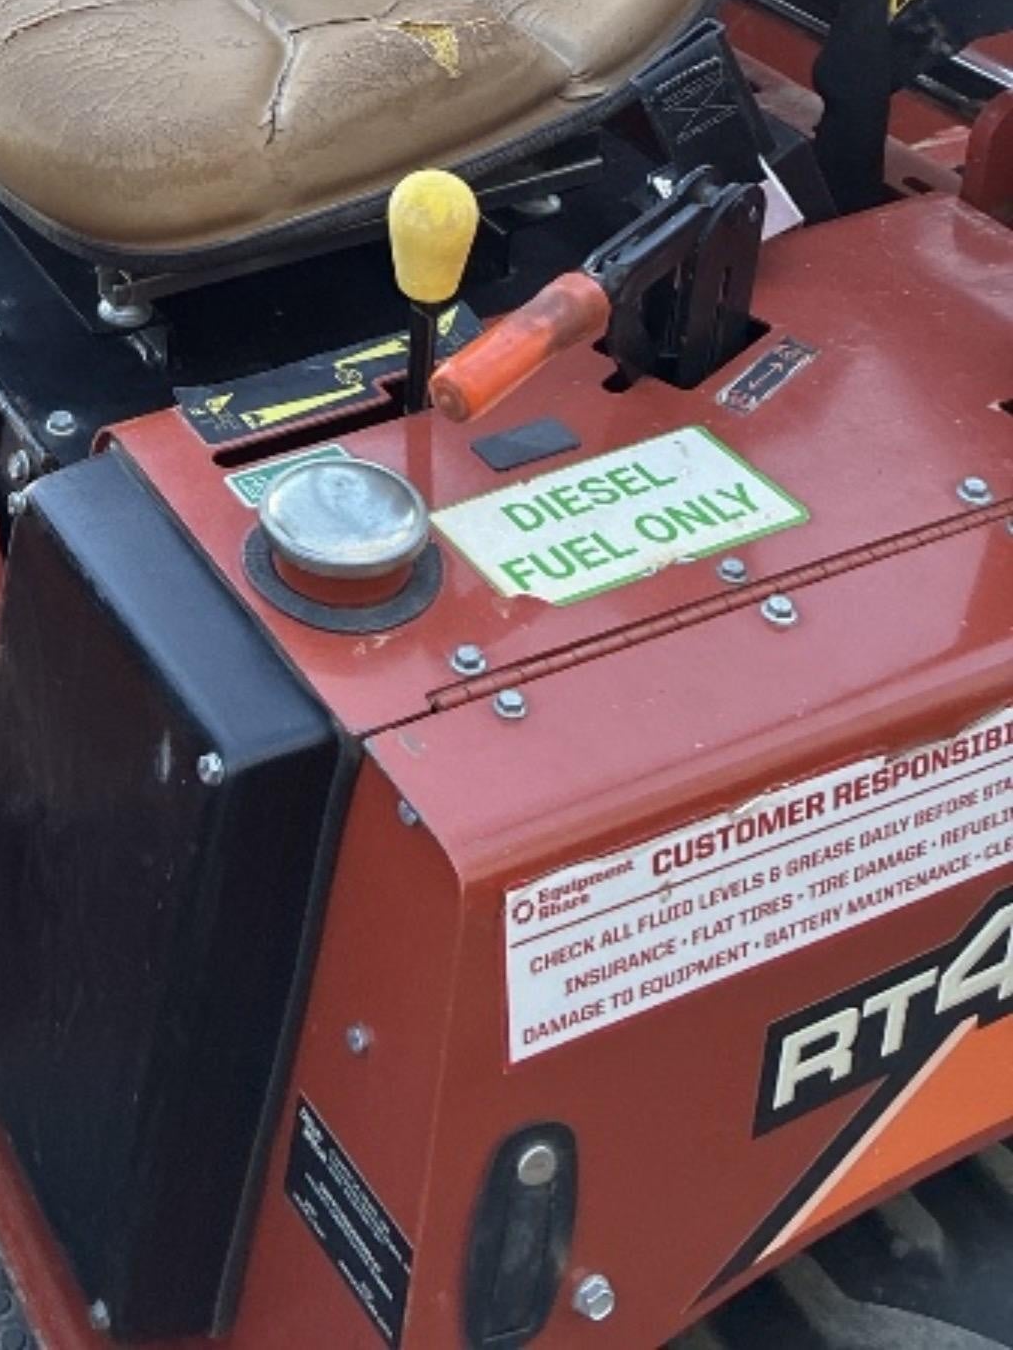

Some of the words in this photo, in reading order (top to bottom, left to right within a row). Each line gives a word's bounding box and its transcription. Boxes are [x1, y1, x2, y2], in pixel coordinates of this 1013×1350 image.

[499, 461, 678, 532] DIESEL
[499, 530, 638, 591] FUEL
[634, 482, 760, 543] ONLY
[529, 935, 596, 975] CHECK
[599, 923, 634, 948] ALL
[637, 900, 694, 933] FLUID
[698, 872, 765, 910] LEVELS
[787, 837, 855, 876] GREASE
[859, 815, 910, 850] DAILY
[913, 788, 979, 828] BEFORE
[537, 860, 635, 903] Equipment
[652, 791, 825, 877] CUSTOMER
[522, 999, 607, 1046] DAMAGE
[611, 987, 634, 1009] TO
[640, 941, 751, 999] EQUIPMENT
[764, 903, 844, 949] BATTERY
[846, 853, 972, 916] MAINTENANCE
[563, 936, 677, 996] INSURANCE
[691, 914, 736, 946] FLAT
[738, 893, 794, 926] TIRES
[808, 869, 850, 900] TIRE
[853, 838, 928, 883] DAMAGE
